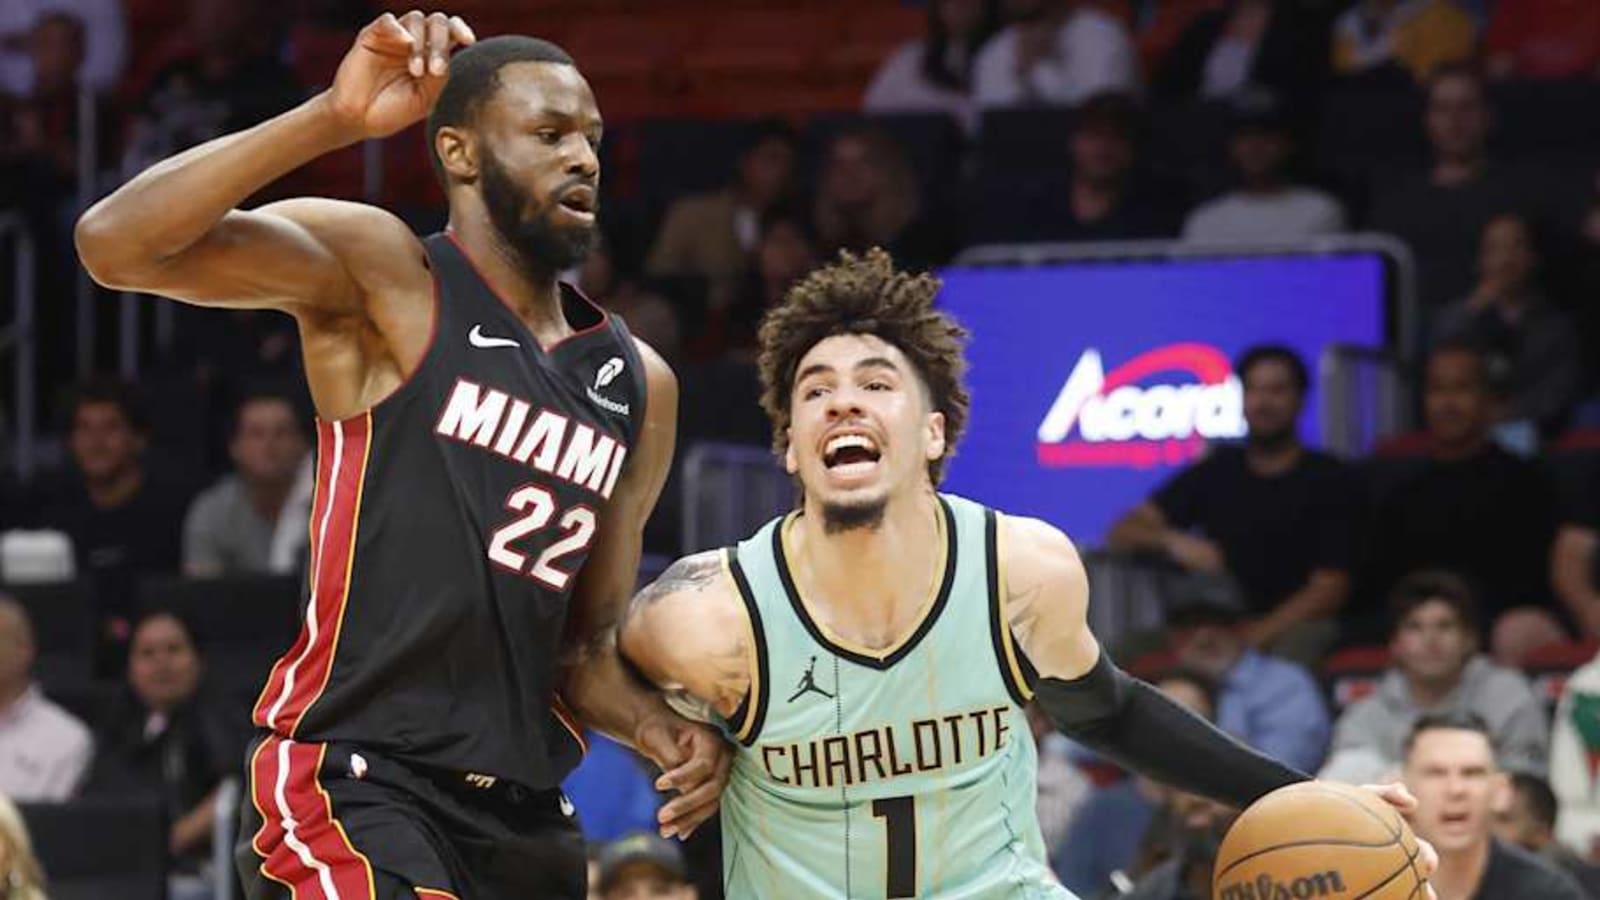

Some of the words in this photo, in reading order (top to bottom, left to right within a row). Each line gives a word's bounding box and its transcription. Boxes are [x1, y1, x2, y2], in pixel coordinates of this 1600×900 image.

[436, 378, 628, 501] MIAMI
[1037, 347, 1248, 443] Acord
[487, 485, 596, 590] 22
[761, 706, 1011, 787] CHARLOTTE
[871, 794, 917, 899] 1
